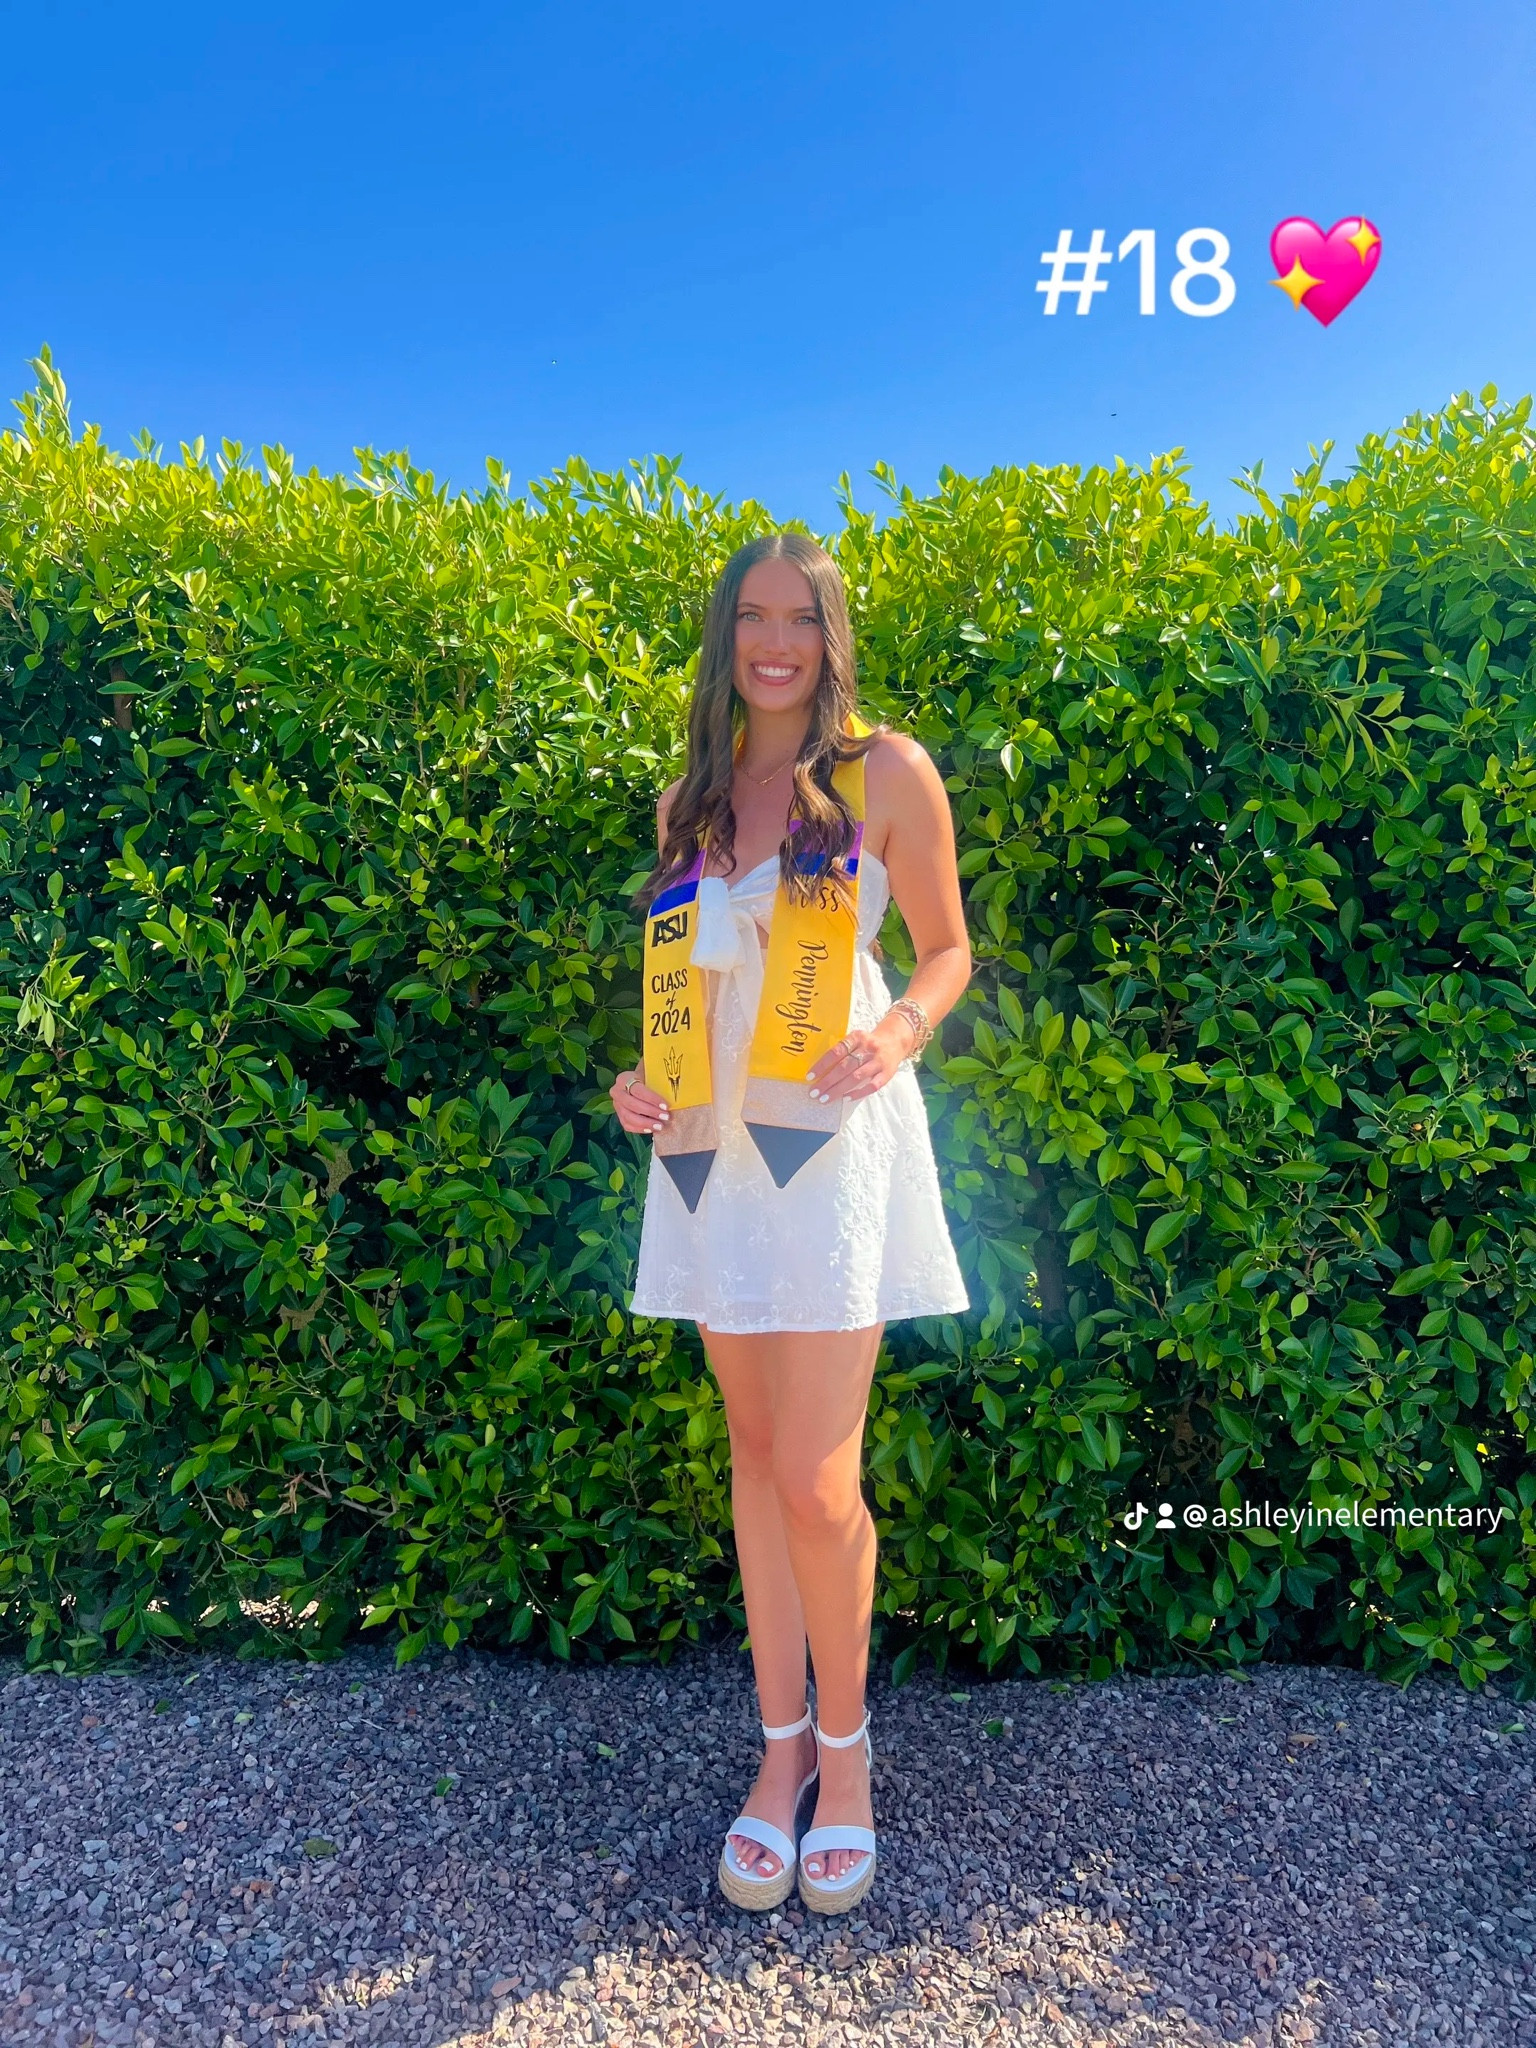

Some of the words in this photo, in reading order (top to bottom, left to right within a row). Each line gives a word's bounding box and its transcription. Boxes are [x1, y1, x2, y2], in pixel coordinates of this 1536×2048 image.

[651, 910, 688, 948] ASU
[651, 968, 688, 994] CLASS
[665, 990, 677, 1011] of
[775, 939, 829, 1057] Pennington
[650, 1006, 691, 1037] 2024
